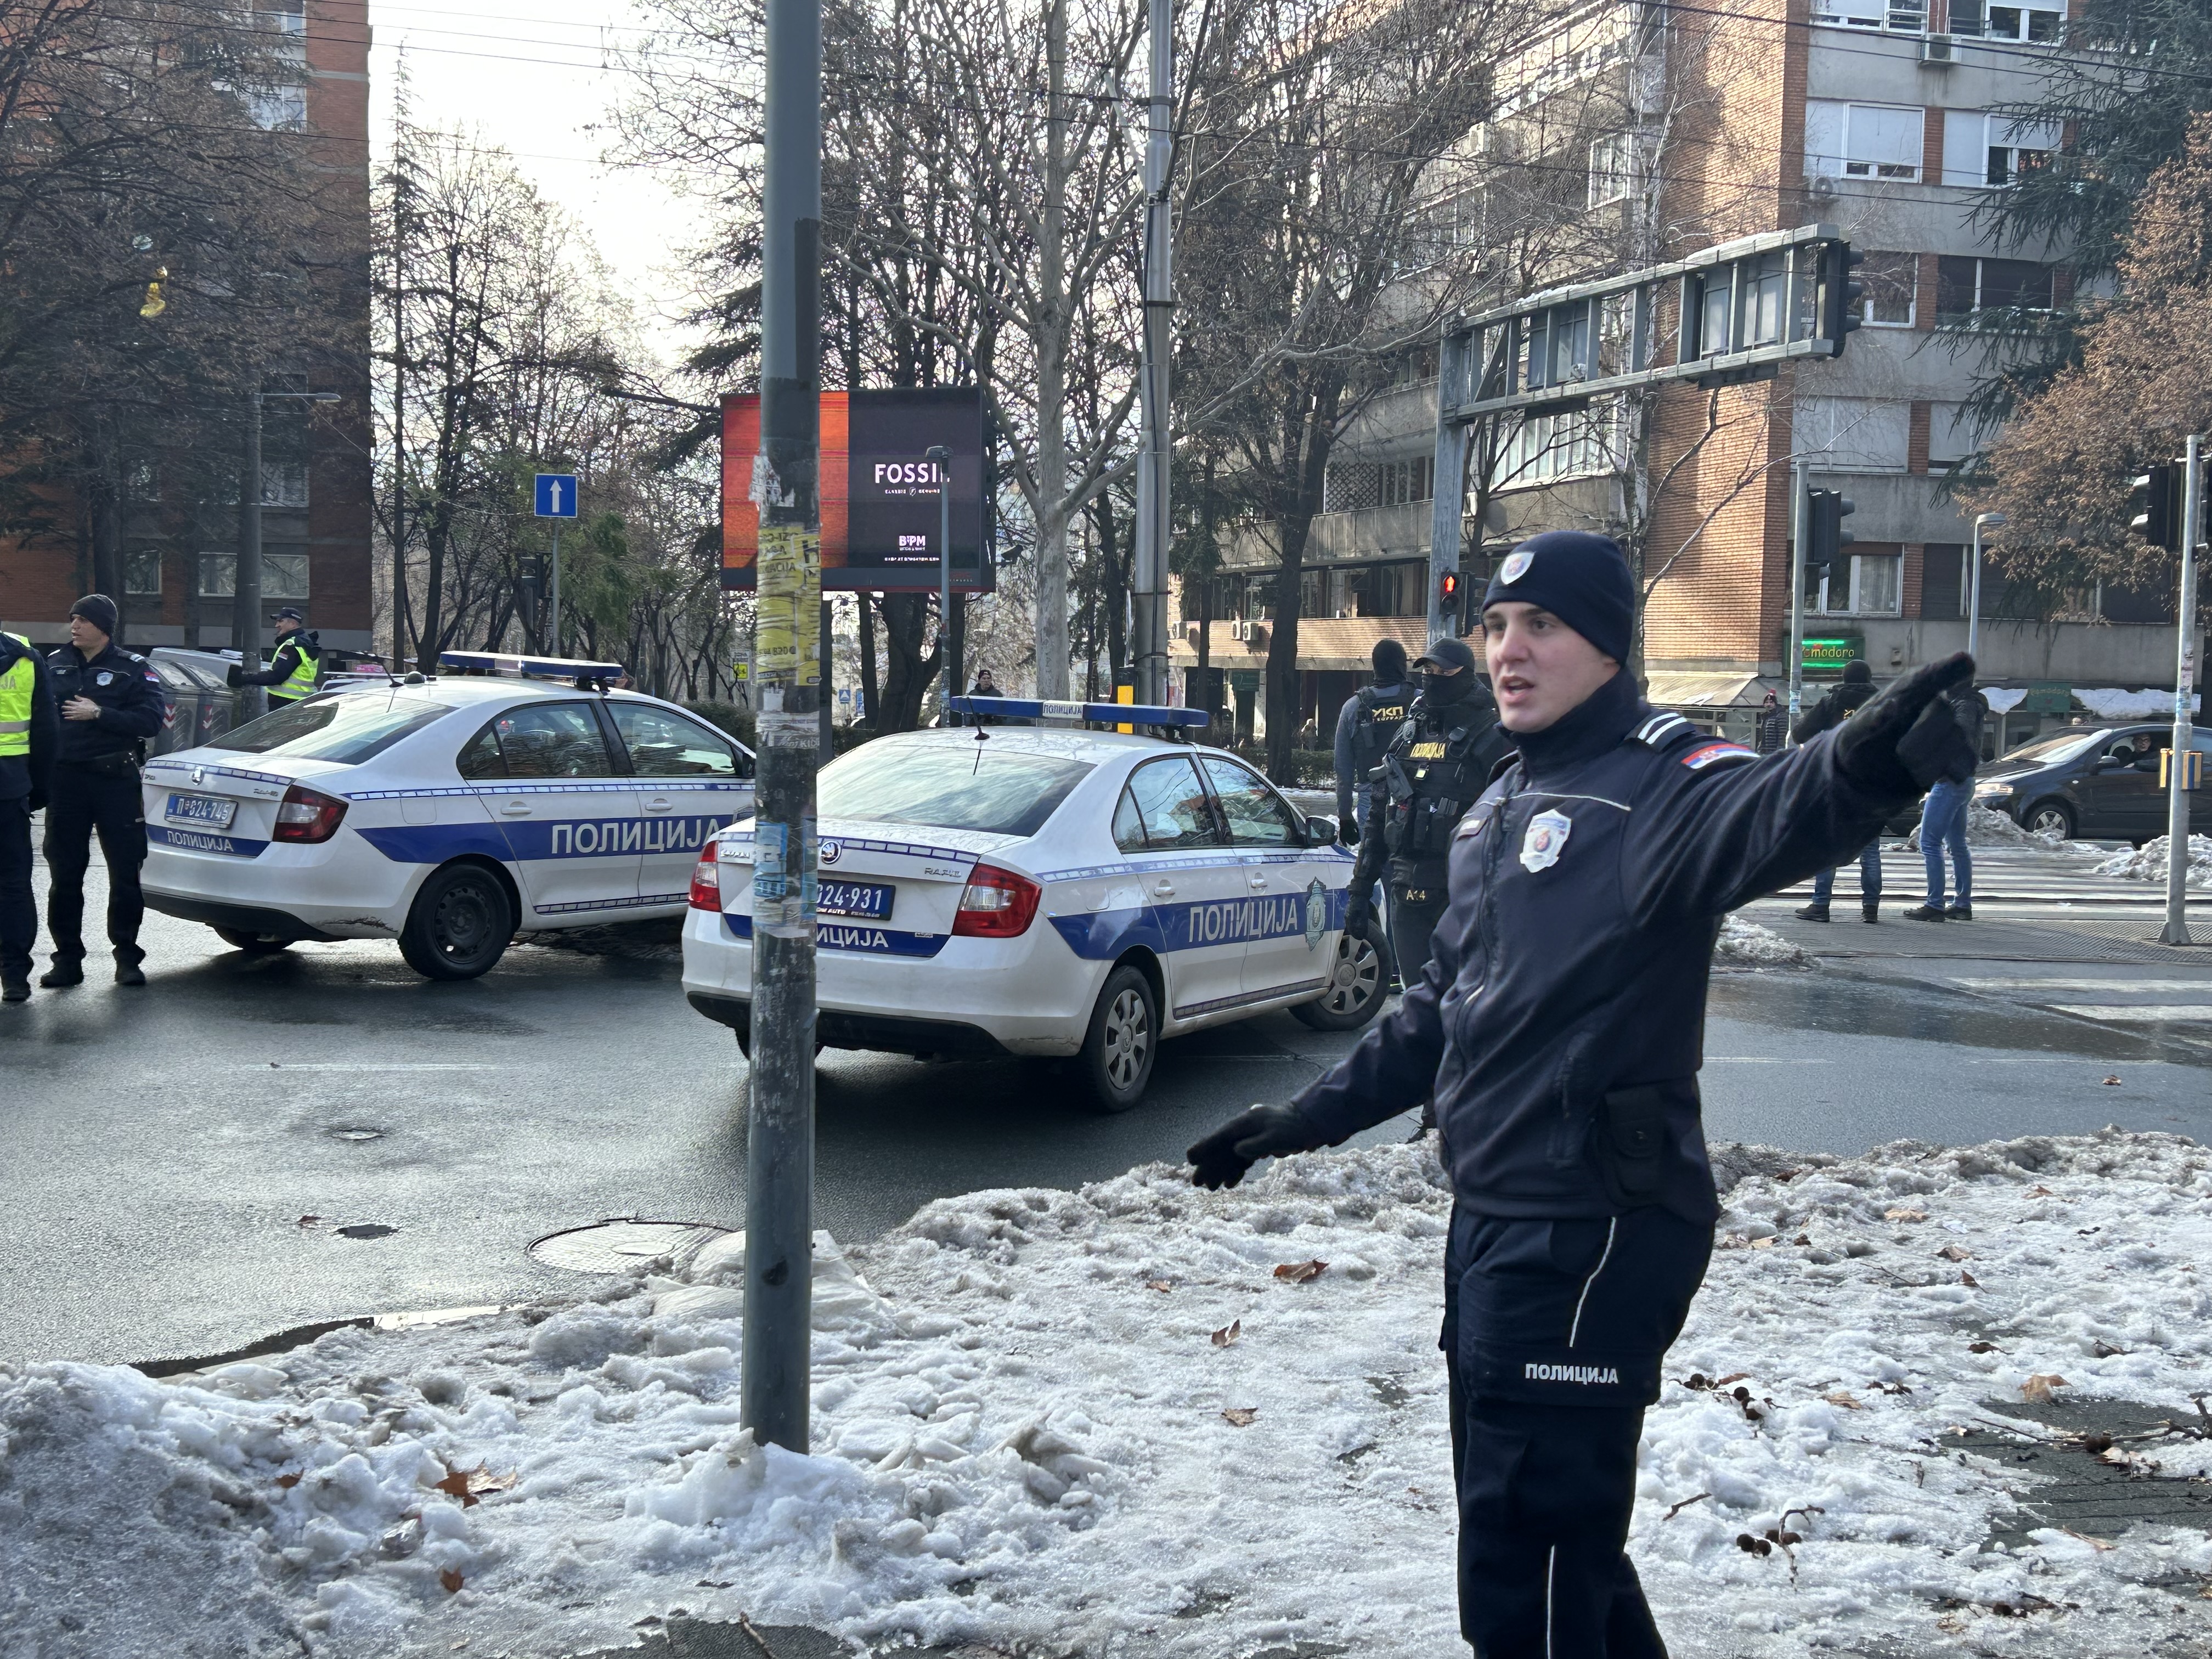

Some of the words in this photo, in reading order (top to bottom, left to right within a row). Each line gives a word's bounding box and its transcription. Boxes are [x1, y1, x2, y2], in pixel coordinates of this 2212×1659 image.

[1043, 703, 1082, 715] ПОЛИЦИЈА
[1372, 706, 1403, 717] УКП
[1409, 742, 1446, 760] ПОЛИЦИЈА
[167, 831, 234, 852] ПОЛИЦИЈА
[551, 819, 720, 854] ПОЛИЦИЈА
[1188, 898, 1298, 943] ПОЛИЦИЈА
[1525, 1363, 1619, 1385] ПОЛИЦИЈА
